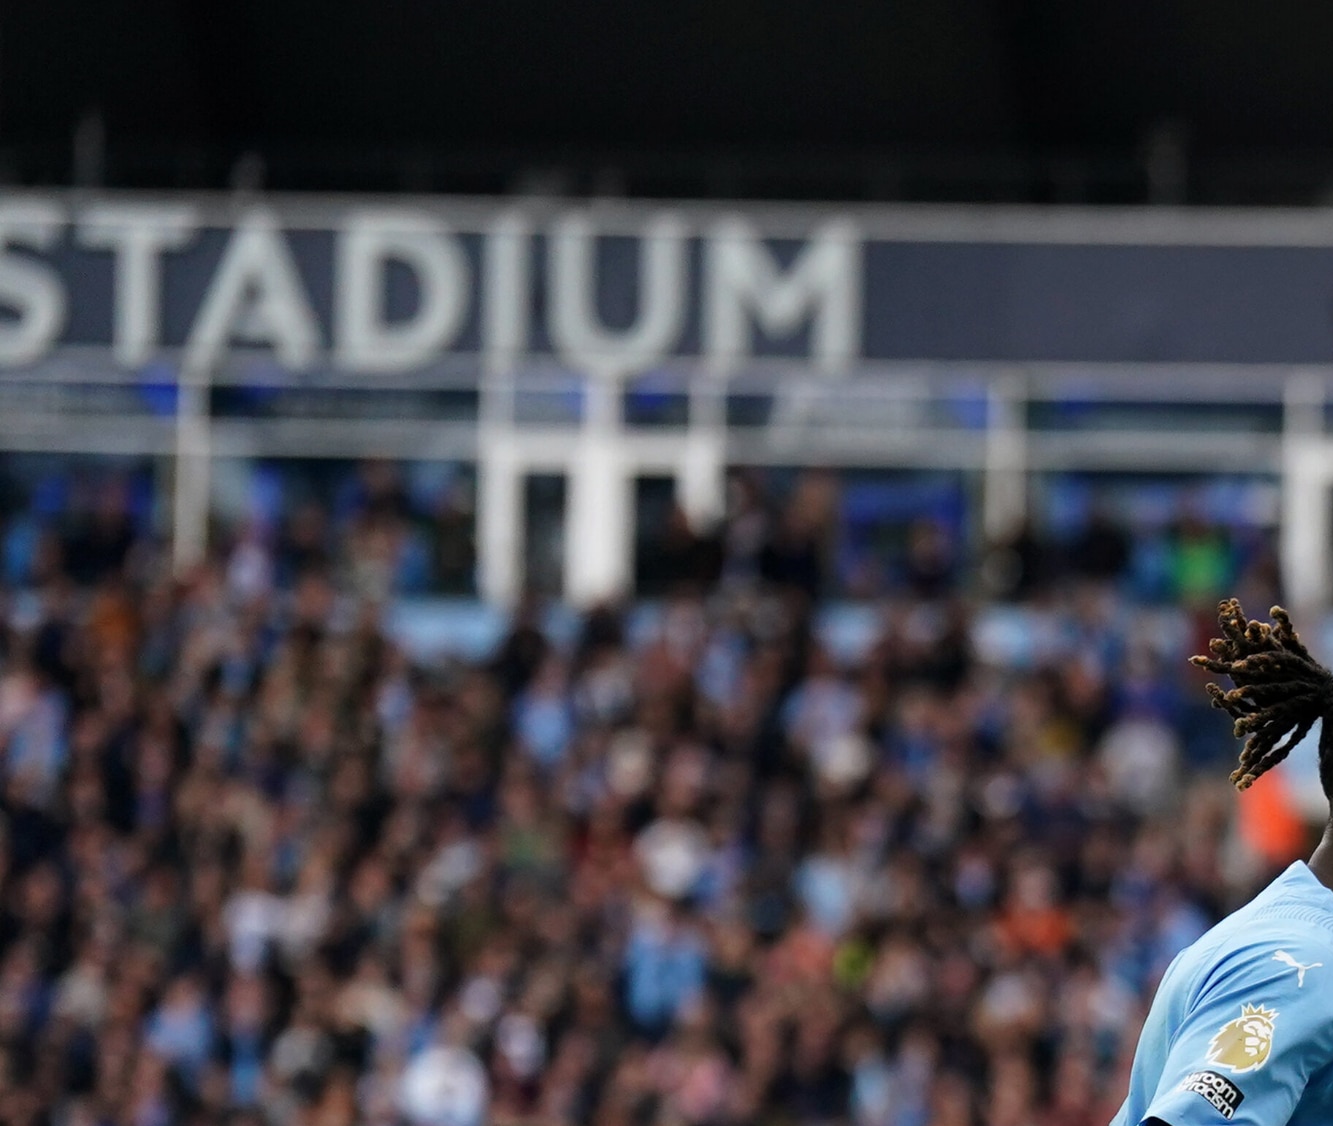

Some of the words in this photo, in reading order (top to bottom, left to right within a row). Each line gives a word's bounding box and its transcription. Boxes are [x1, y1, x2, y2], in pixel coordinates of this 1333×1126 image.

[0, 207, 865, 376] STADIUM
[1188, 1081, 1235, 1119] racism
[1197, 1073, 1237, 1103] room
